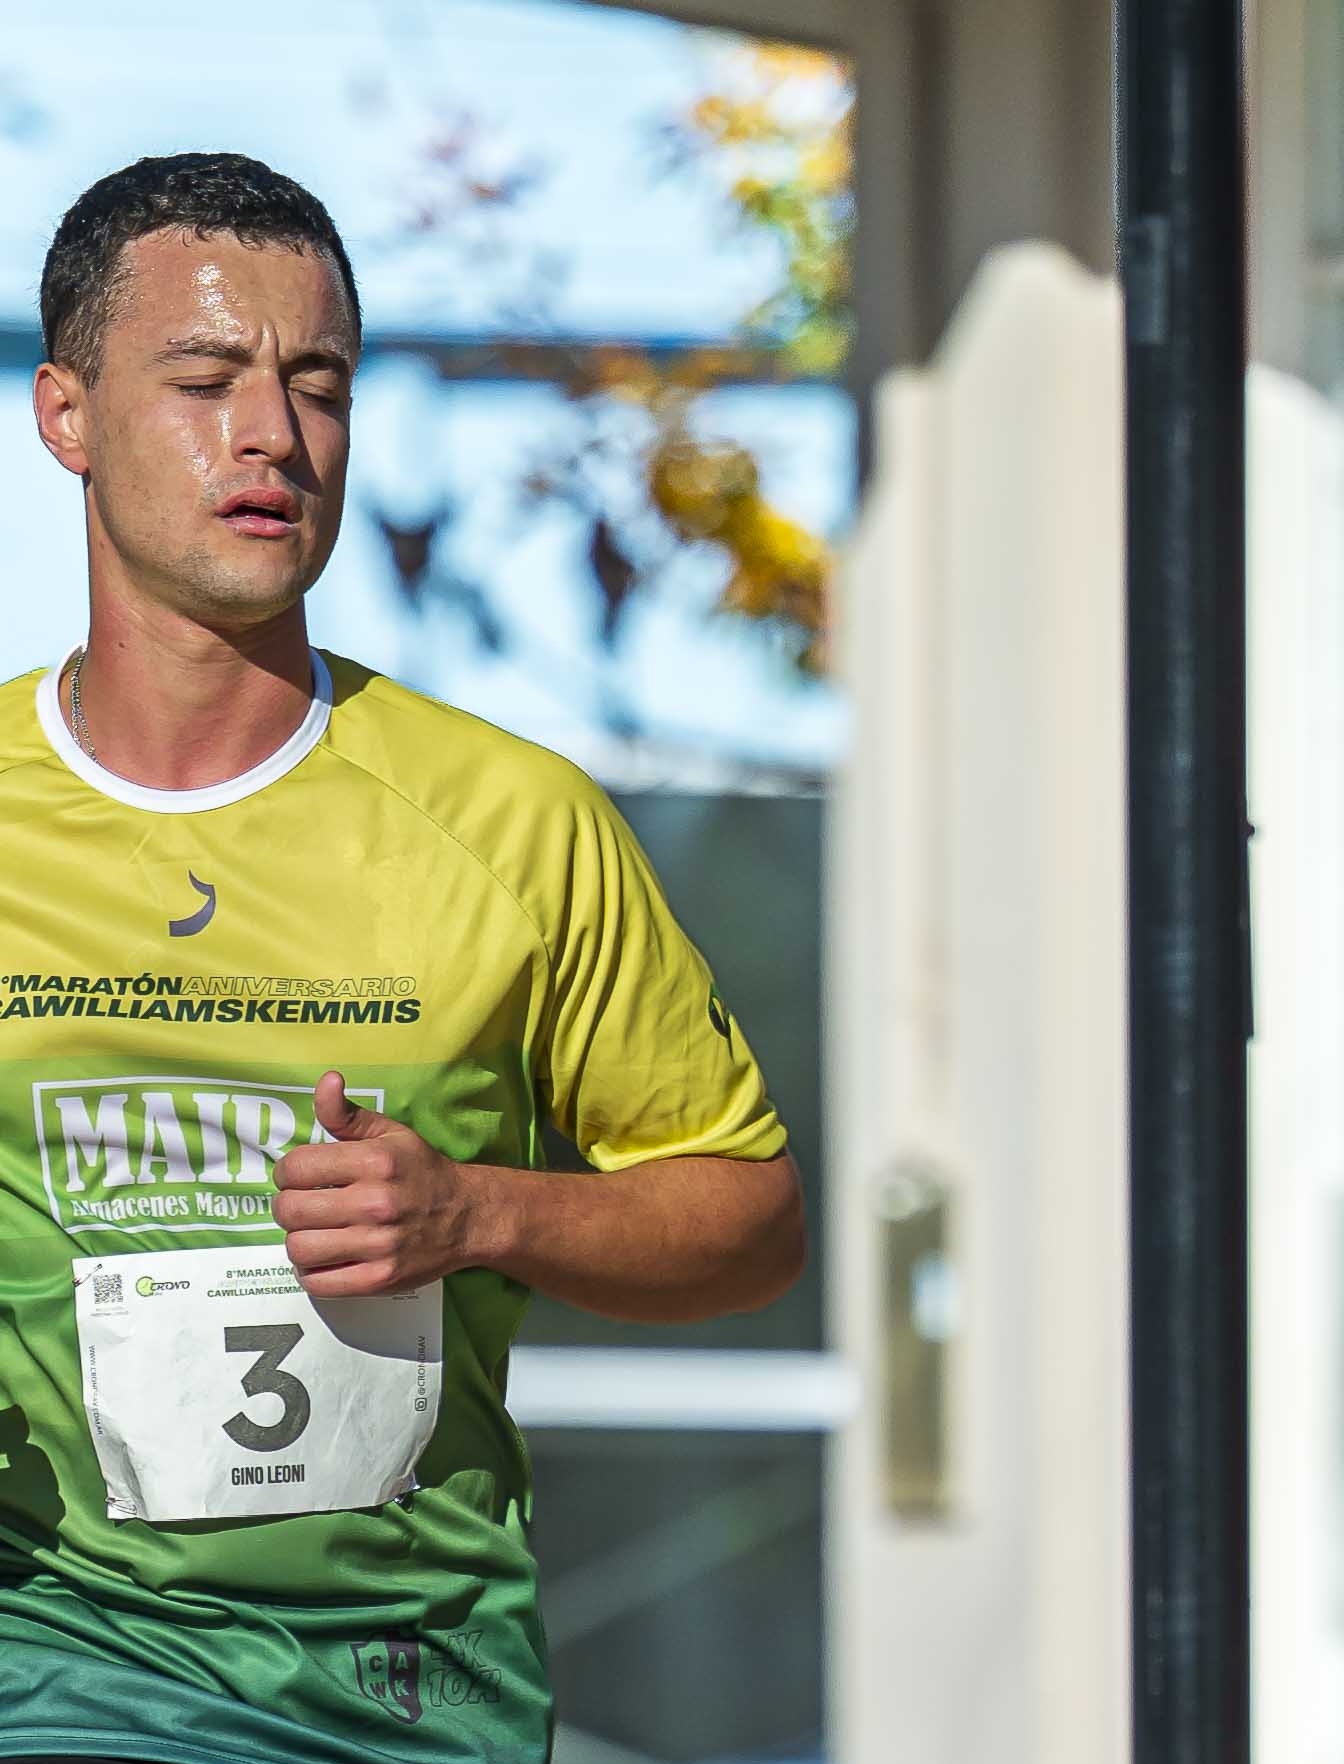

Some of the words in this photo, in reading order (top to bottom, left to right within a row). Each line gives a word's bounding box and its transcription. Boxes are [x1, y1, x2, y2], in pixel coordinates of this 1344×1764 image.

[55, 1092, 339, 1192] MAIR
[72, 1193, 189, 1222] Almacenes
[195, 1191, 272, 1219] Mayori
[207, 1286, 305, 1298] CAWILLIAMSKEMM
[222, 1323, 311, 1452] 3
[231, 1466, 264, 1486] GINO
[267, 1464, 305, 1484] LEONI
